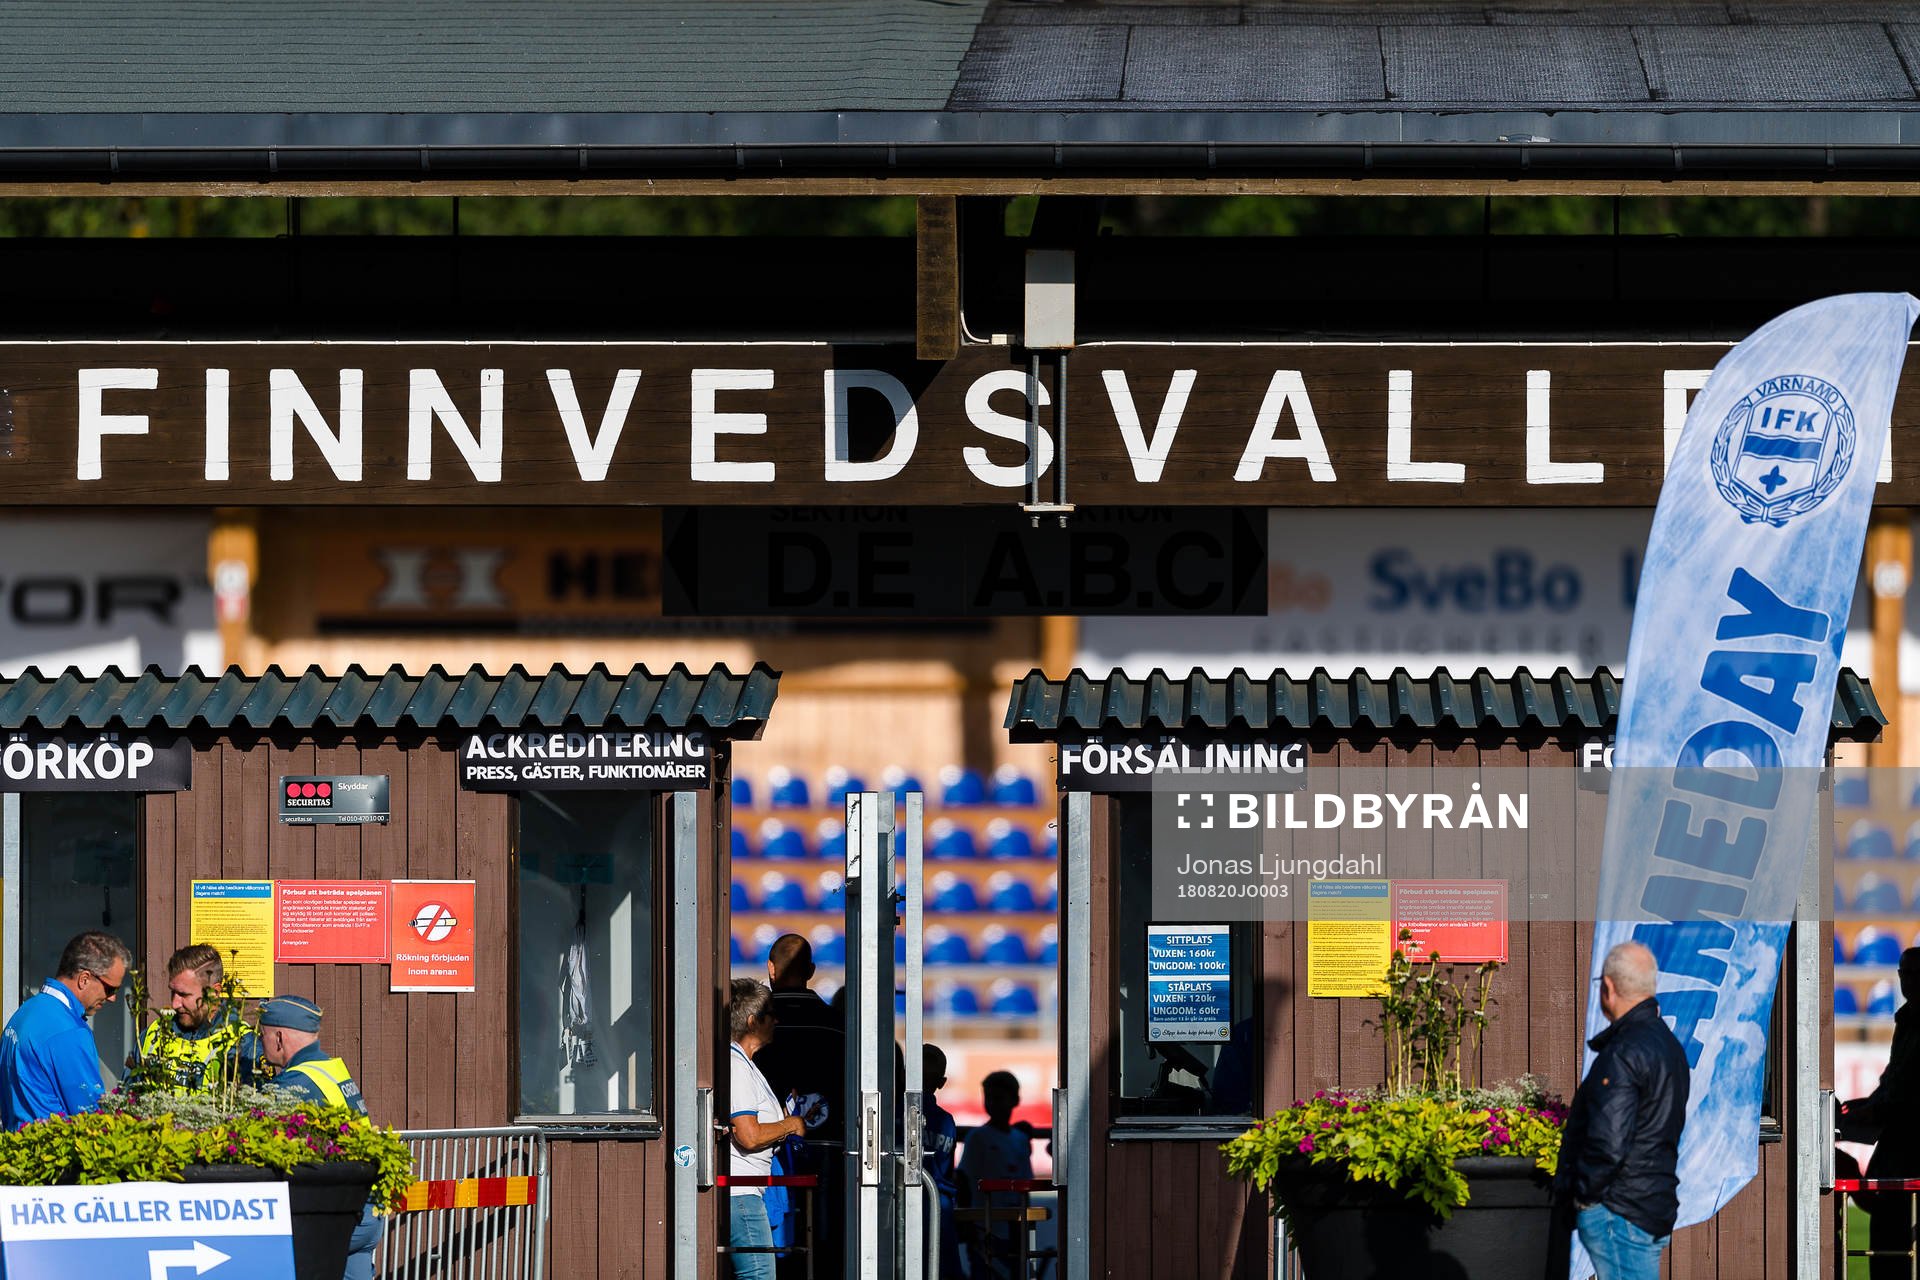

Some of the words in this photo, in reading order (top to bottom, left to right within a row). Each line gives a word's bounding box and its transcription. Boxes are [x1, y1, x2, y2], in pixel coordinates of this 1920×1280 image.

[1755, 377, 1839, 404] VÄRNAMO
[77, 367, 1891, 487] FINNVEDSVALL
[1761, 407, 1820, 432] IFK
[1369, 548, 1581, 614] SveBo
[0, 576, 182, 626] OR
[0, 733, 154, 779] ÖRKÖP
[466, 733, 705, 758] ACKREDITERING
[1062, 736, 1304, 774] FÖRSÄLJNING
[467, 765, 517, 781] PRESS,
[522, 763, 584, 780] GÄSTER,
[588, 762, 705, 779] FUNKTIONÄRER
[338, 783, 368, 791] Skyddar
[1167, 936, 1213, 944] SITTPLATS
[396, 954, 430, 962] Rökning
[431, 954, 470, 962] förbjuden
[1153, 962, 1196, 970] UNGDOM:
[1199, 961, 1226, 970] 100kr
[1168, 982, 1212, 991] STÅPLATS
[1153, 1007, 1196, 1015] UNGDOM:
[11, 1198, 67, 1226] HÄR
[74, 1197, 172, 1224] GÄLLER
[179, 1198, 278, 1222] ENDAST
